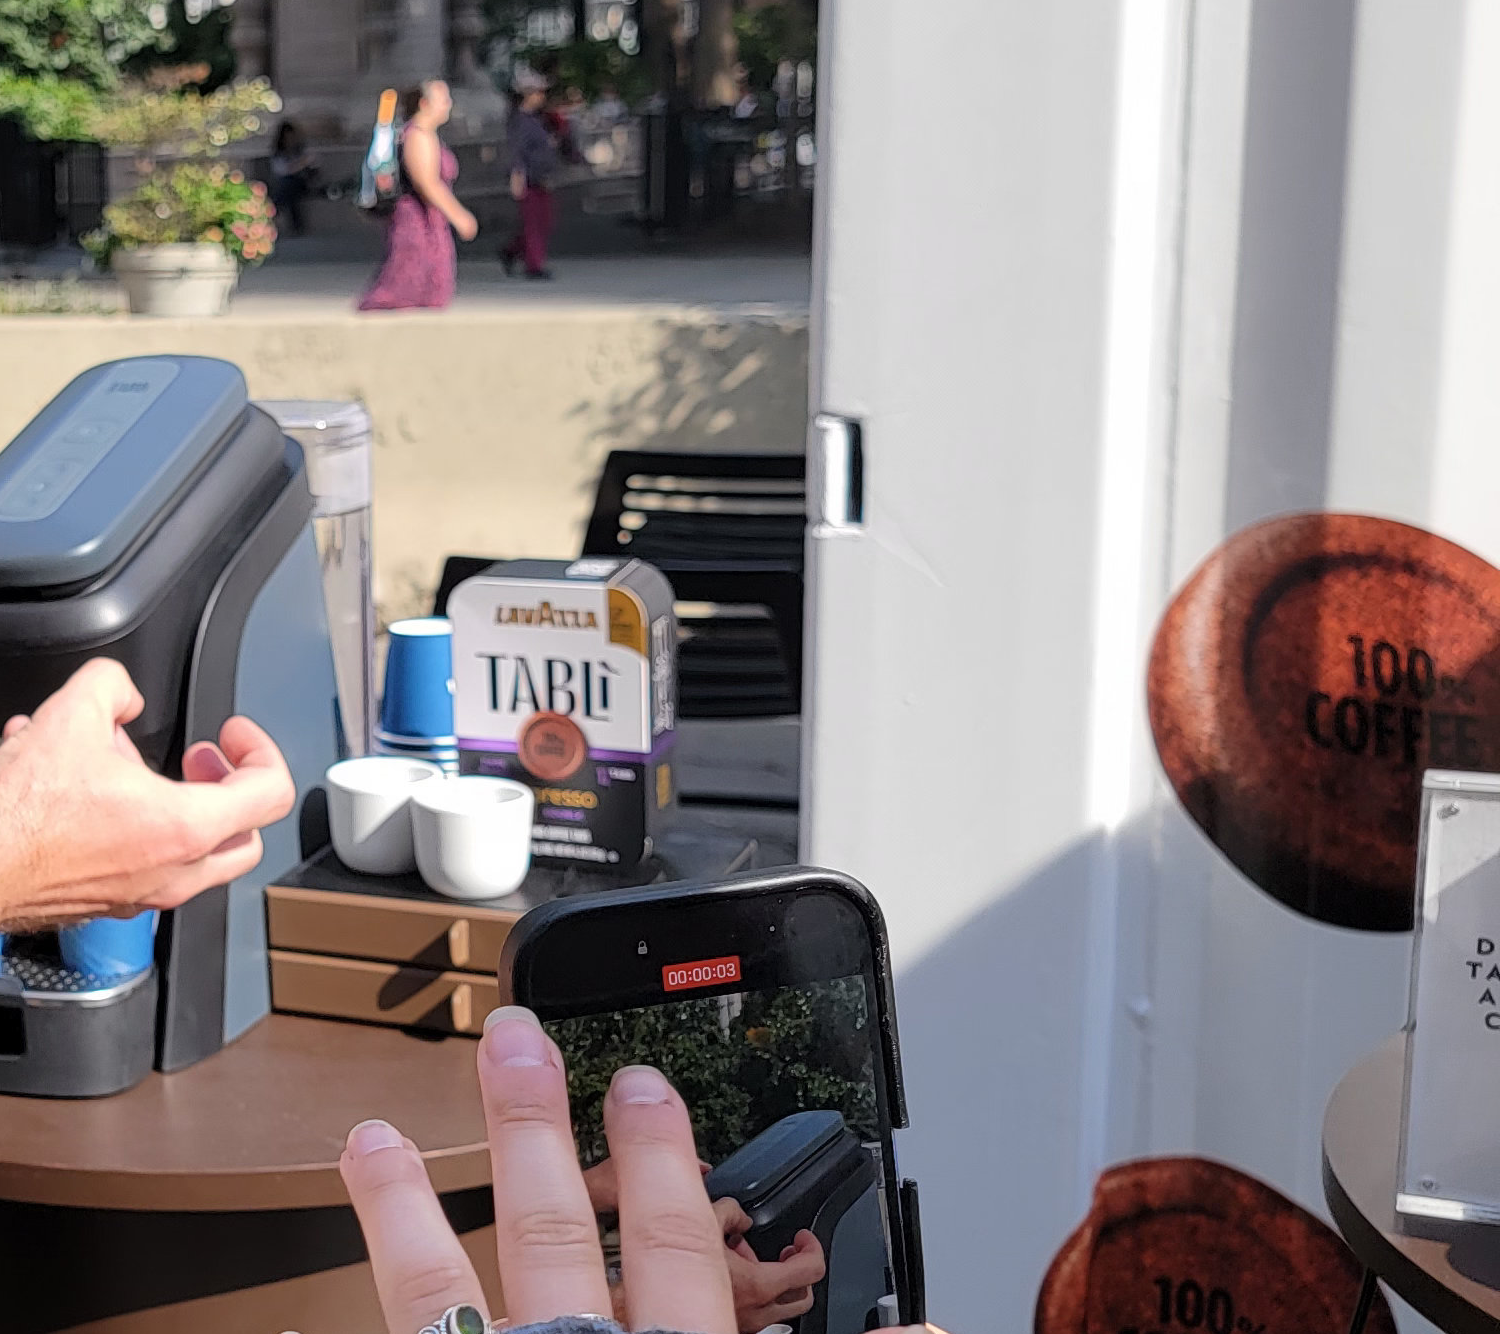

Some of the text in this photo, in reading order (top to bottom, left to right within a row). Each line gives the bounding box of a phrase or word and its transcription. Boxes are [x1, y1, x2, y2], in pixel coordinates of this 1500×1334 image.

[1347, 633, 1476, 706] 100%
[1305, 690, 1478, 767] COFFEE
[668, 962, 736, 986] 00:00:03
